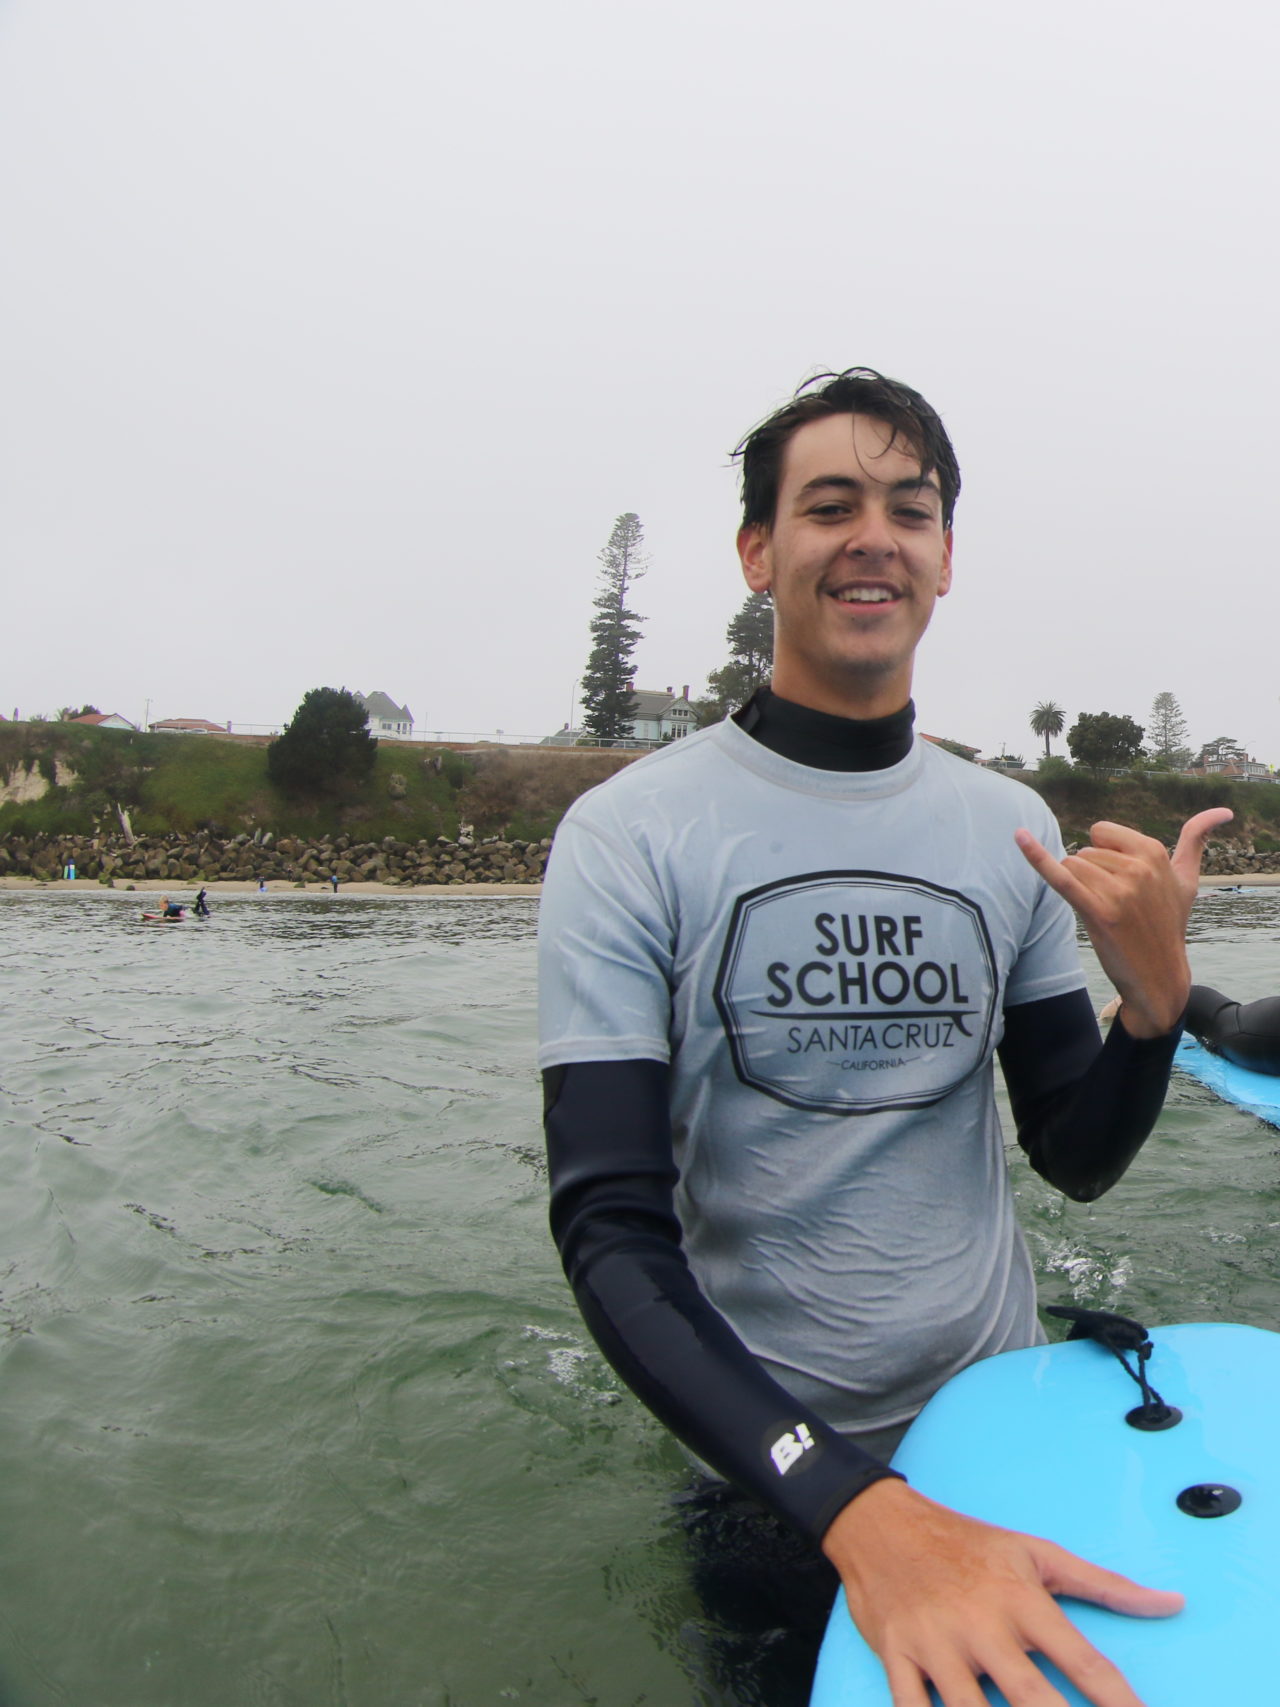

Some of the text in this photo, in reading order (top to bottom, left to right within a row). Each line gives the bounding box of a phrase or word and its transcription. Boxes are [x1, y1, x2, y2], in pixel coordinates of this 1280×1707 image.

[814, 912, 924, 957] SURF
[765, 961, 969, 1008] SCHOOL
[787, 1022, 955, 1054] SANTA CRUZ
[840, 1057, 907, 1071] CALIFORNIA
